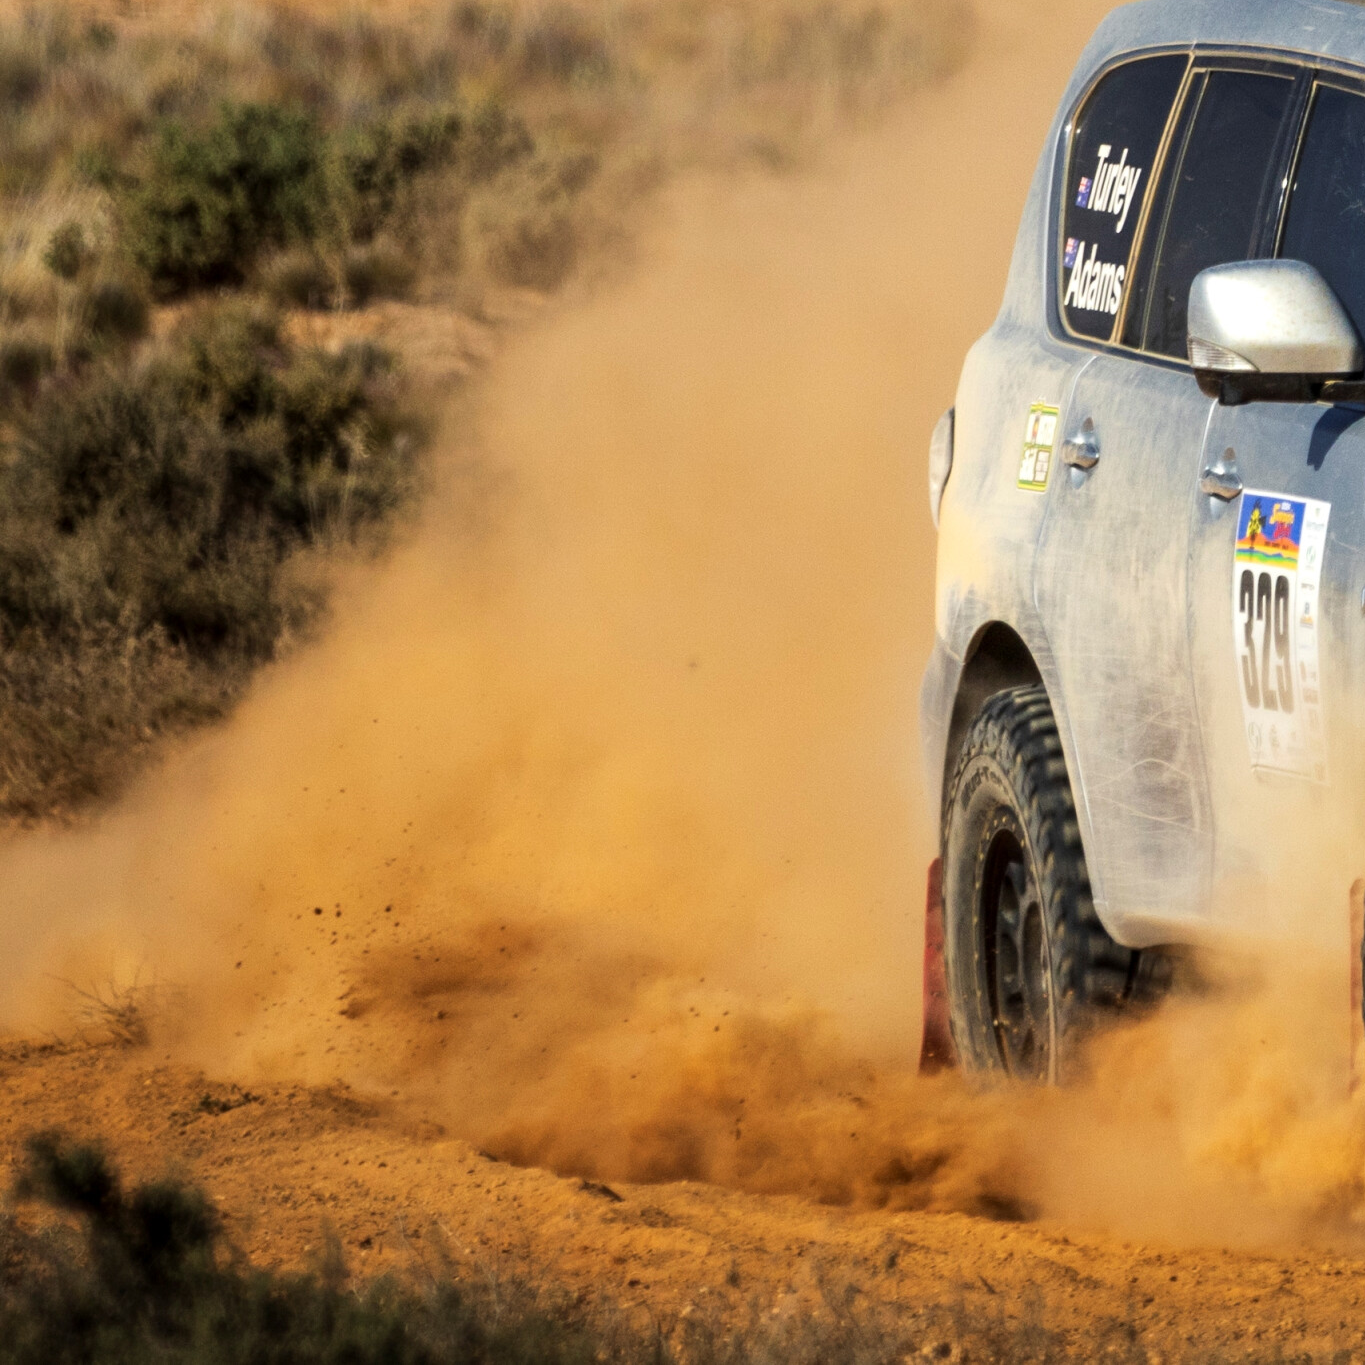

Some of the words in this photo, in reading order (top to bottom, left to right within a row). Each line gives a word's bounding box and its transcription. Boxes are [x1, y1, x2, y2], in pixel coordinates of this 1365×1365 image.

[1087, 144, 1142, 234] Turley
[1064, 240, 1126, 316] Adams
[1239, 569, 1295, 715] 329
